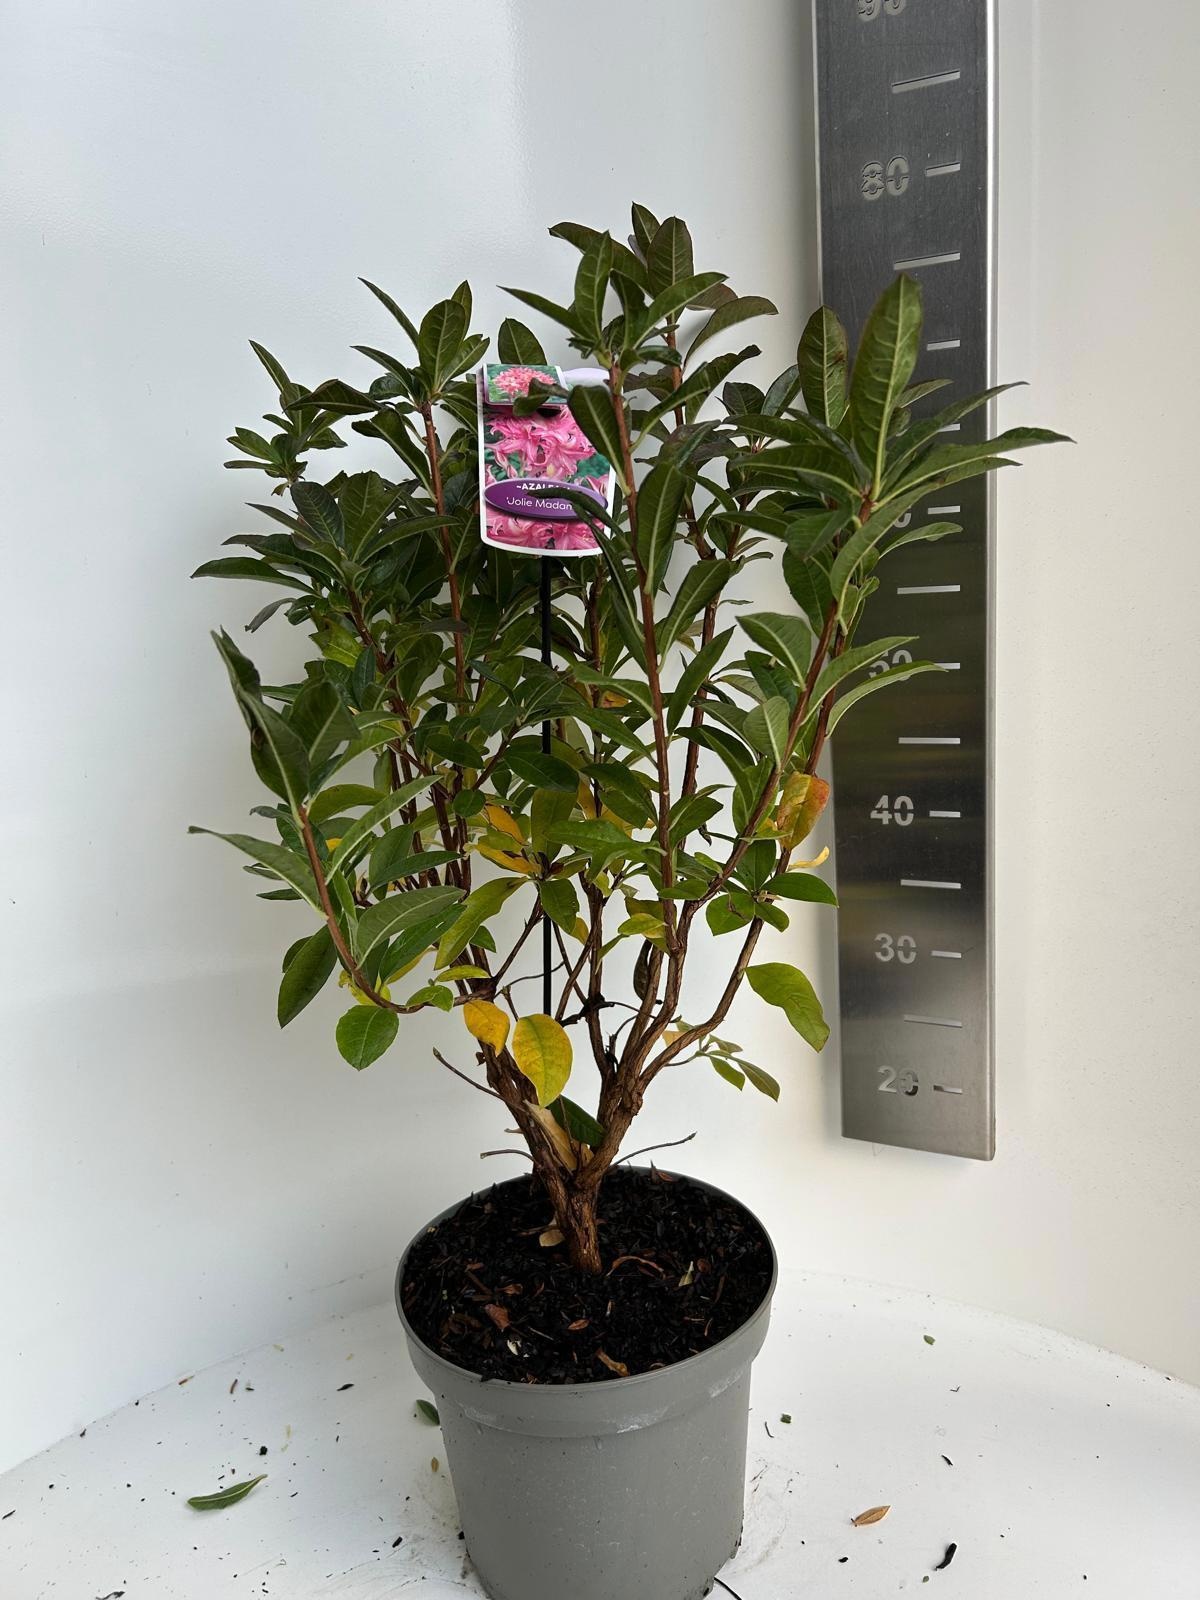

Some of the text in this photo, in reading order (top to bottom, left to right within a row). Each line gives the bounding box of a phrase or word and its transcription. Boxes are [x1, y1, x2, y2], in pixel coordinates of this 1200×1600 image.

[861, 156, 910, 200] 80
[870, 795, 914, 826] 40
[874, 933, 917, 964] 30
[877, 1065, 919, 1096] 20
